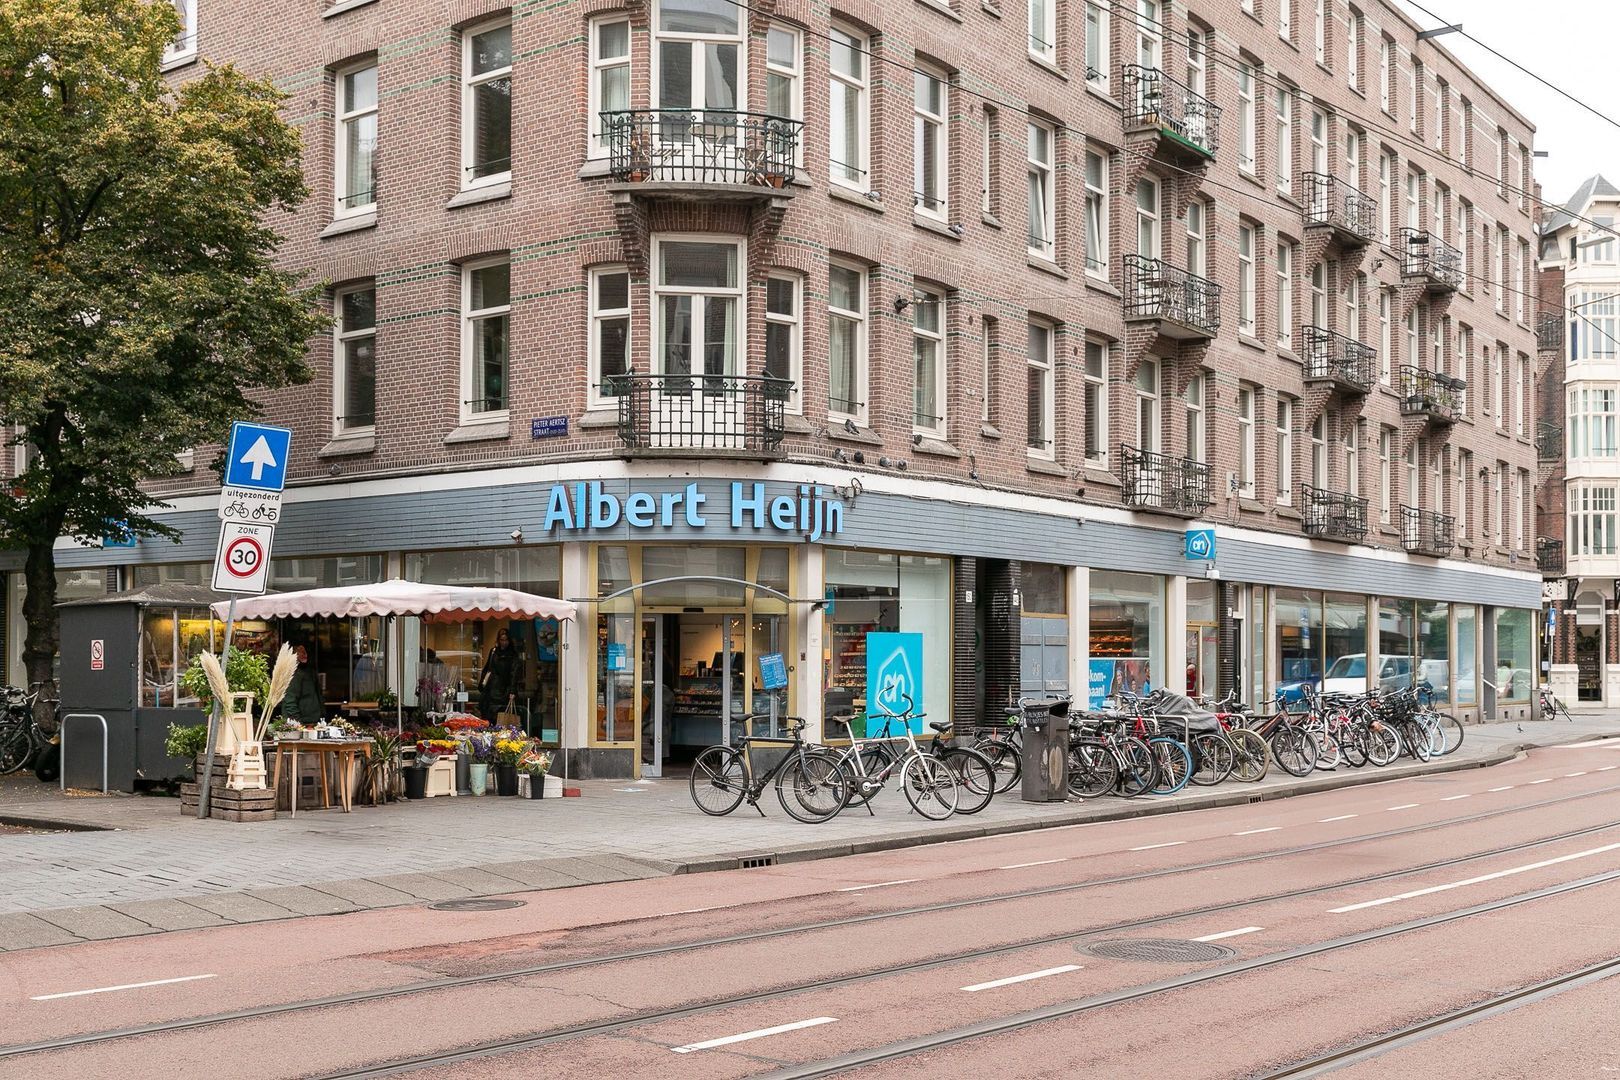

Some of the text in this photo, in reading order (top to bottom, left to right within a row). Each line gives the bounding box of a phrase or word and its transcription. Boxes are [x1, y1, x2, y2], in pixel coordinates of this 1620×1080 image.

[533, 420, 548, 428] PIETER
[533, 428, 549, 436] STRAAT
[227, 490, 280, 501] uitgezonderd
[544, 481, 843, 543] Albert Heijn
[237, 526, 259, 535] ZONE
[232, 549, 256, 565] 30
